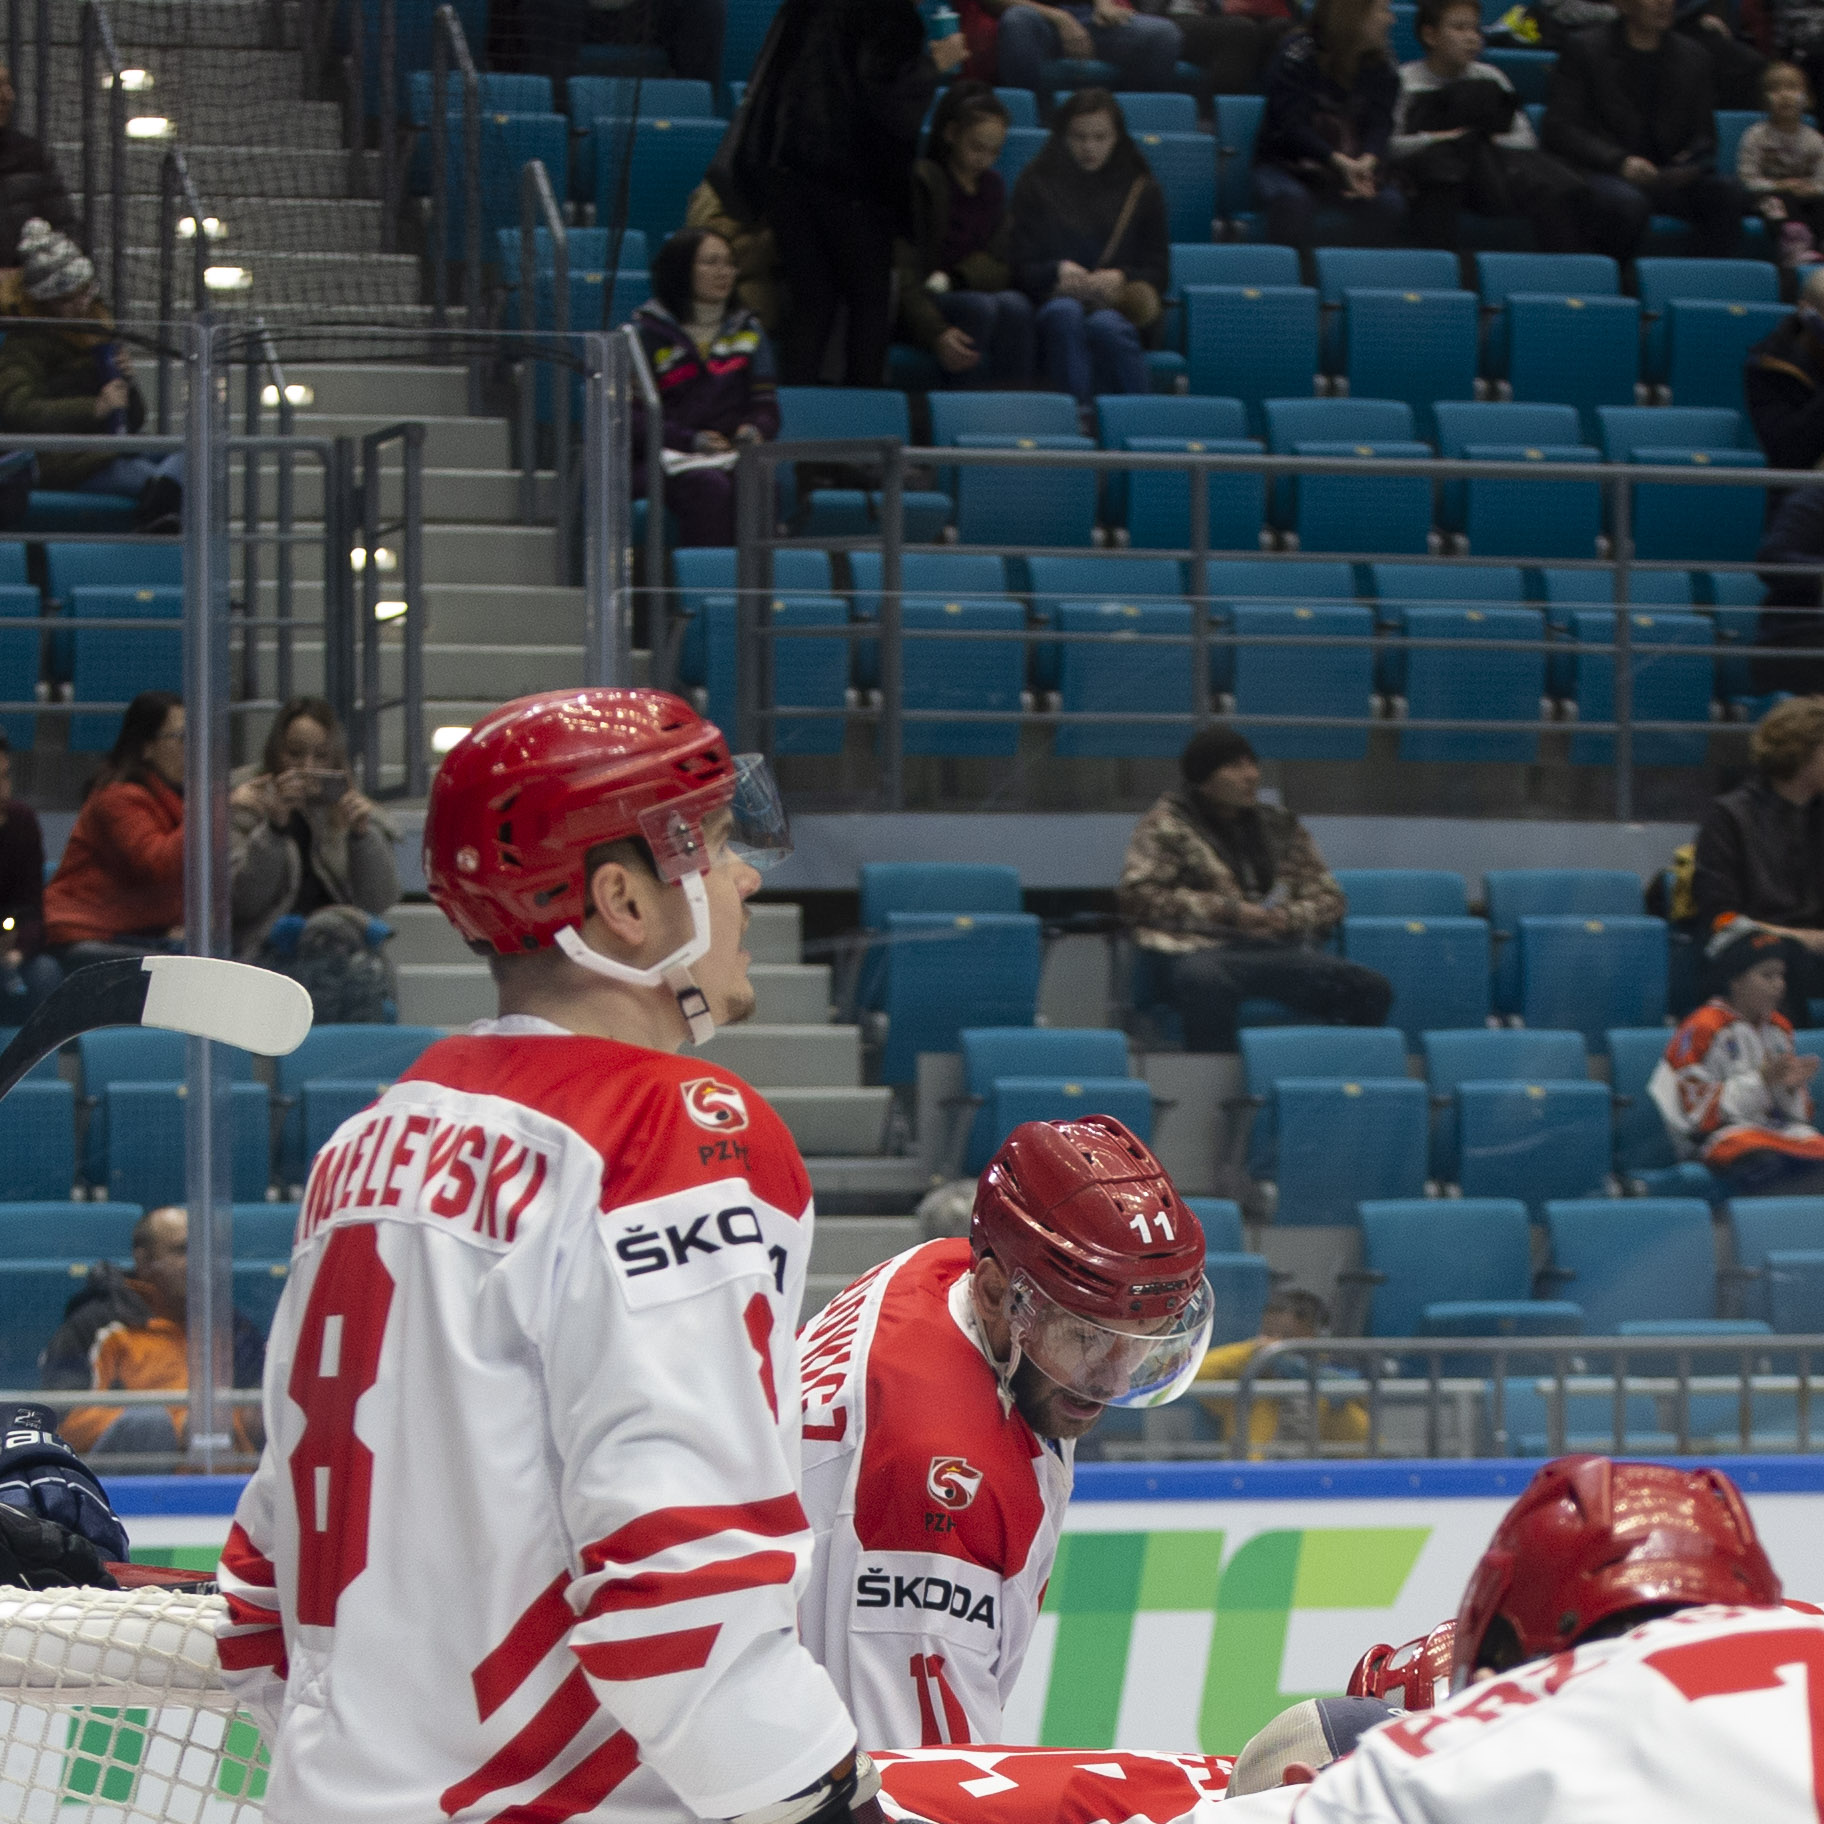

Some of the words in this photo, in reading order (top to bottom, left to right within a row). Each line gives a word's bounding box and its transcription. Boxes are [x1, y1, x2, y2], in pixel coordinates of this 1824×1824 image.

[1128, 1210, 1176, 1245] 11
[288, 1220, 397, 1628] 8
[856, 1568, 996, 1632] ŠKODA
